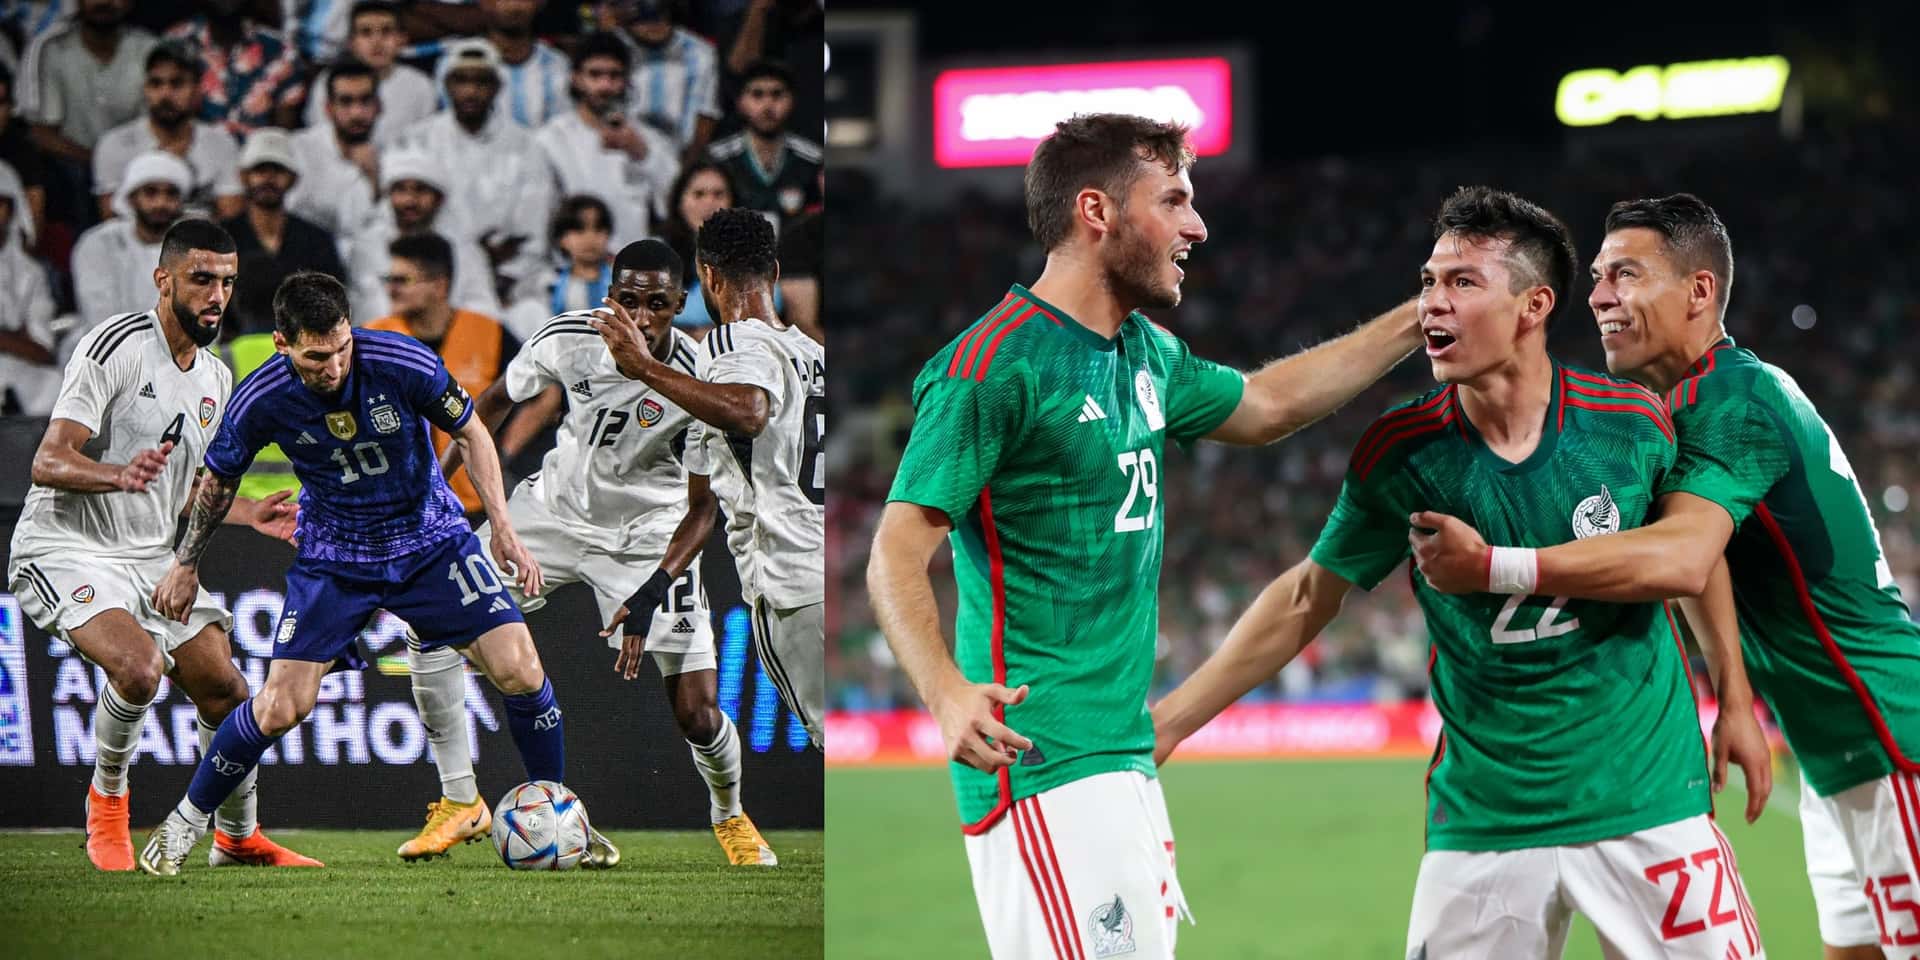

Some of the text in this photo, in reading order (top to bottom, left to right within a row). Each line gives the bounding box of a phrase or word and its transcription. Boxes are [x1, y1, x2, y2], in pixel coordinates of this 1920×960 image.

[160, 413, 185, 446] 4
[588, 408, 630, 448] 12
[330, 441, 390, 485] 10
[1114, 448, 1158, 533] 29
[448, 554, 503, 606] 10
[1644, 847, 1738, 941] 22
[1864, 874, 1920, 946] 15
